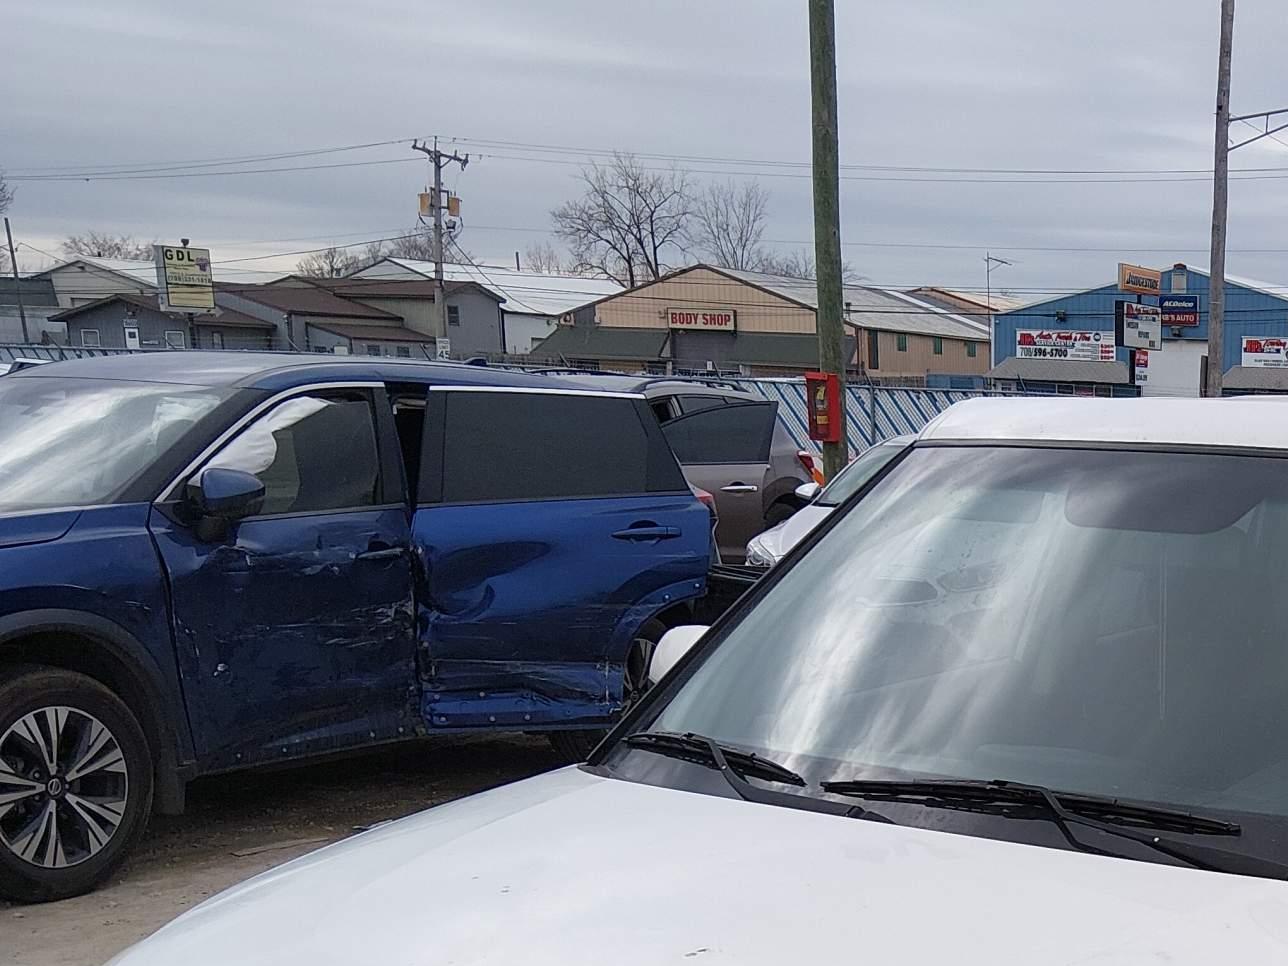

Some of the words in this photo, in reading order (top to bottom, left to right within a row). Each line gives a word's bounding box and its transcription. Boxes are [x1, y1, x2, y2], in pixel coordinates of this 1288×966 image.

[165, 249, 195, 262] GDL
[1163, 300, 1194, 308] ACDelco
[671, 312, 699, 324] BODY
[702, 313, 731, 326] SHOP
